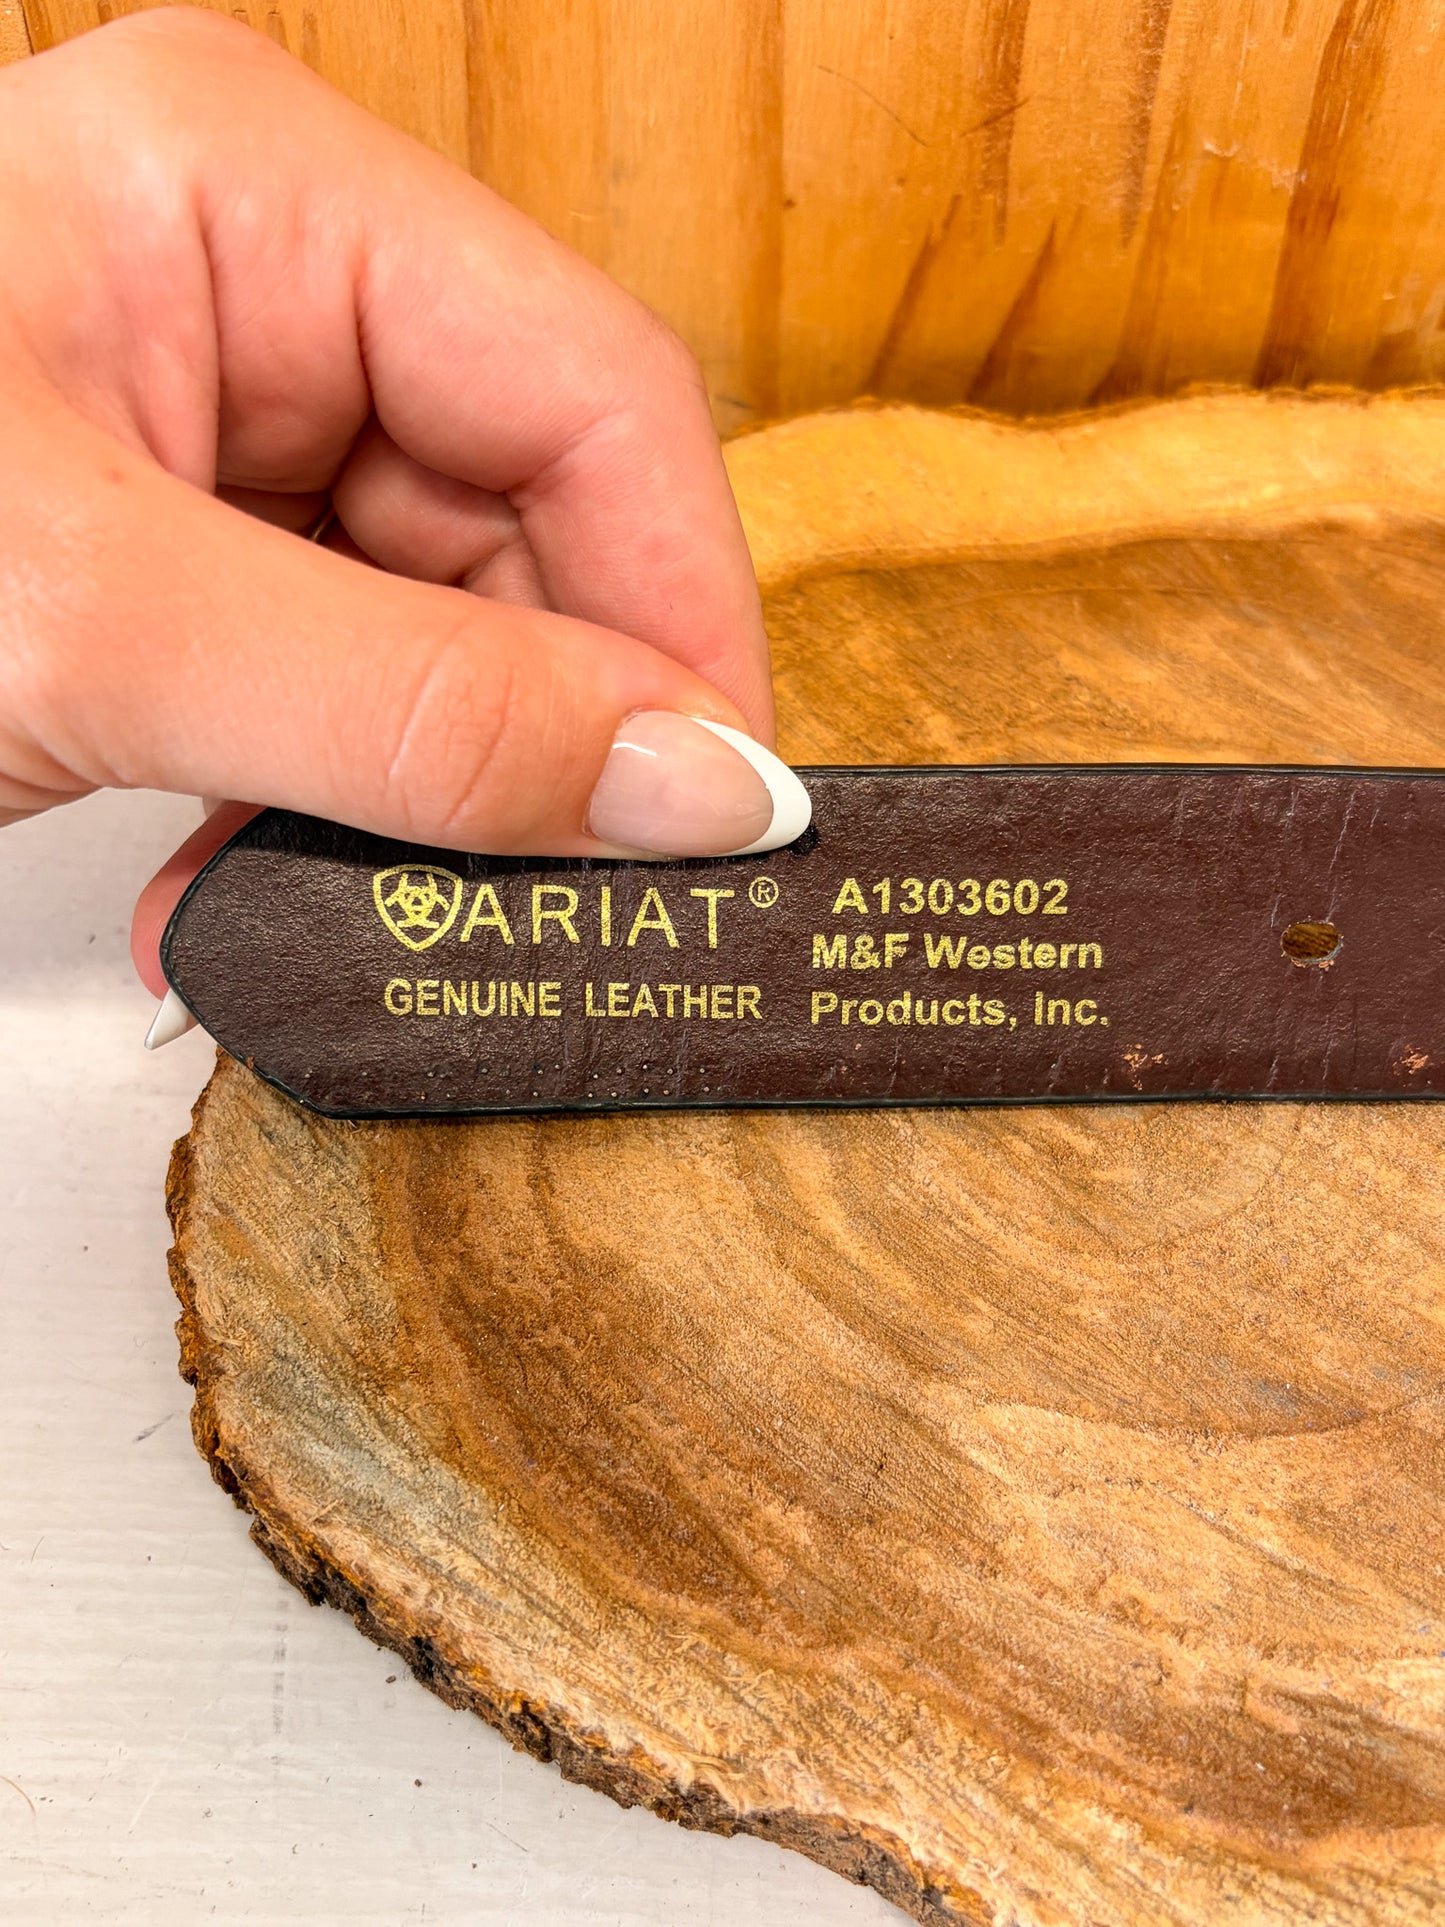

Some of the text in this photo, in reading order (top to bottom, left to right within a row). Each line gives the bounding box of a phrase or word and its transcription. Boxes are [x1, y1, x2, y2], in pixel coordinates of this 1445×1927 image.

[831, 876, 1069, 916] A1303602
[811, 933, 1103, 970] M&F Western
[384, 978, 763, 1020] GENUINE LEATHER
[810, 991, 1109, 1032] Products, Inc.
